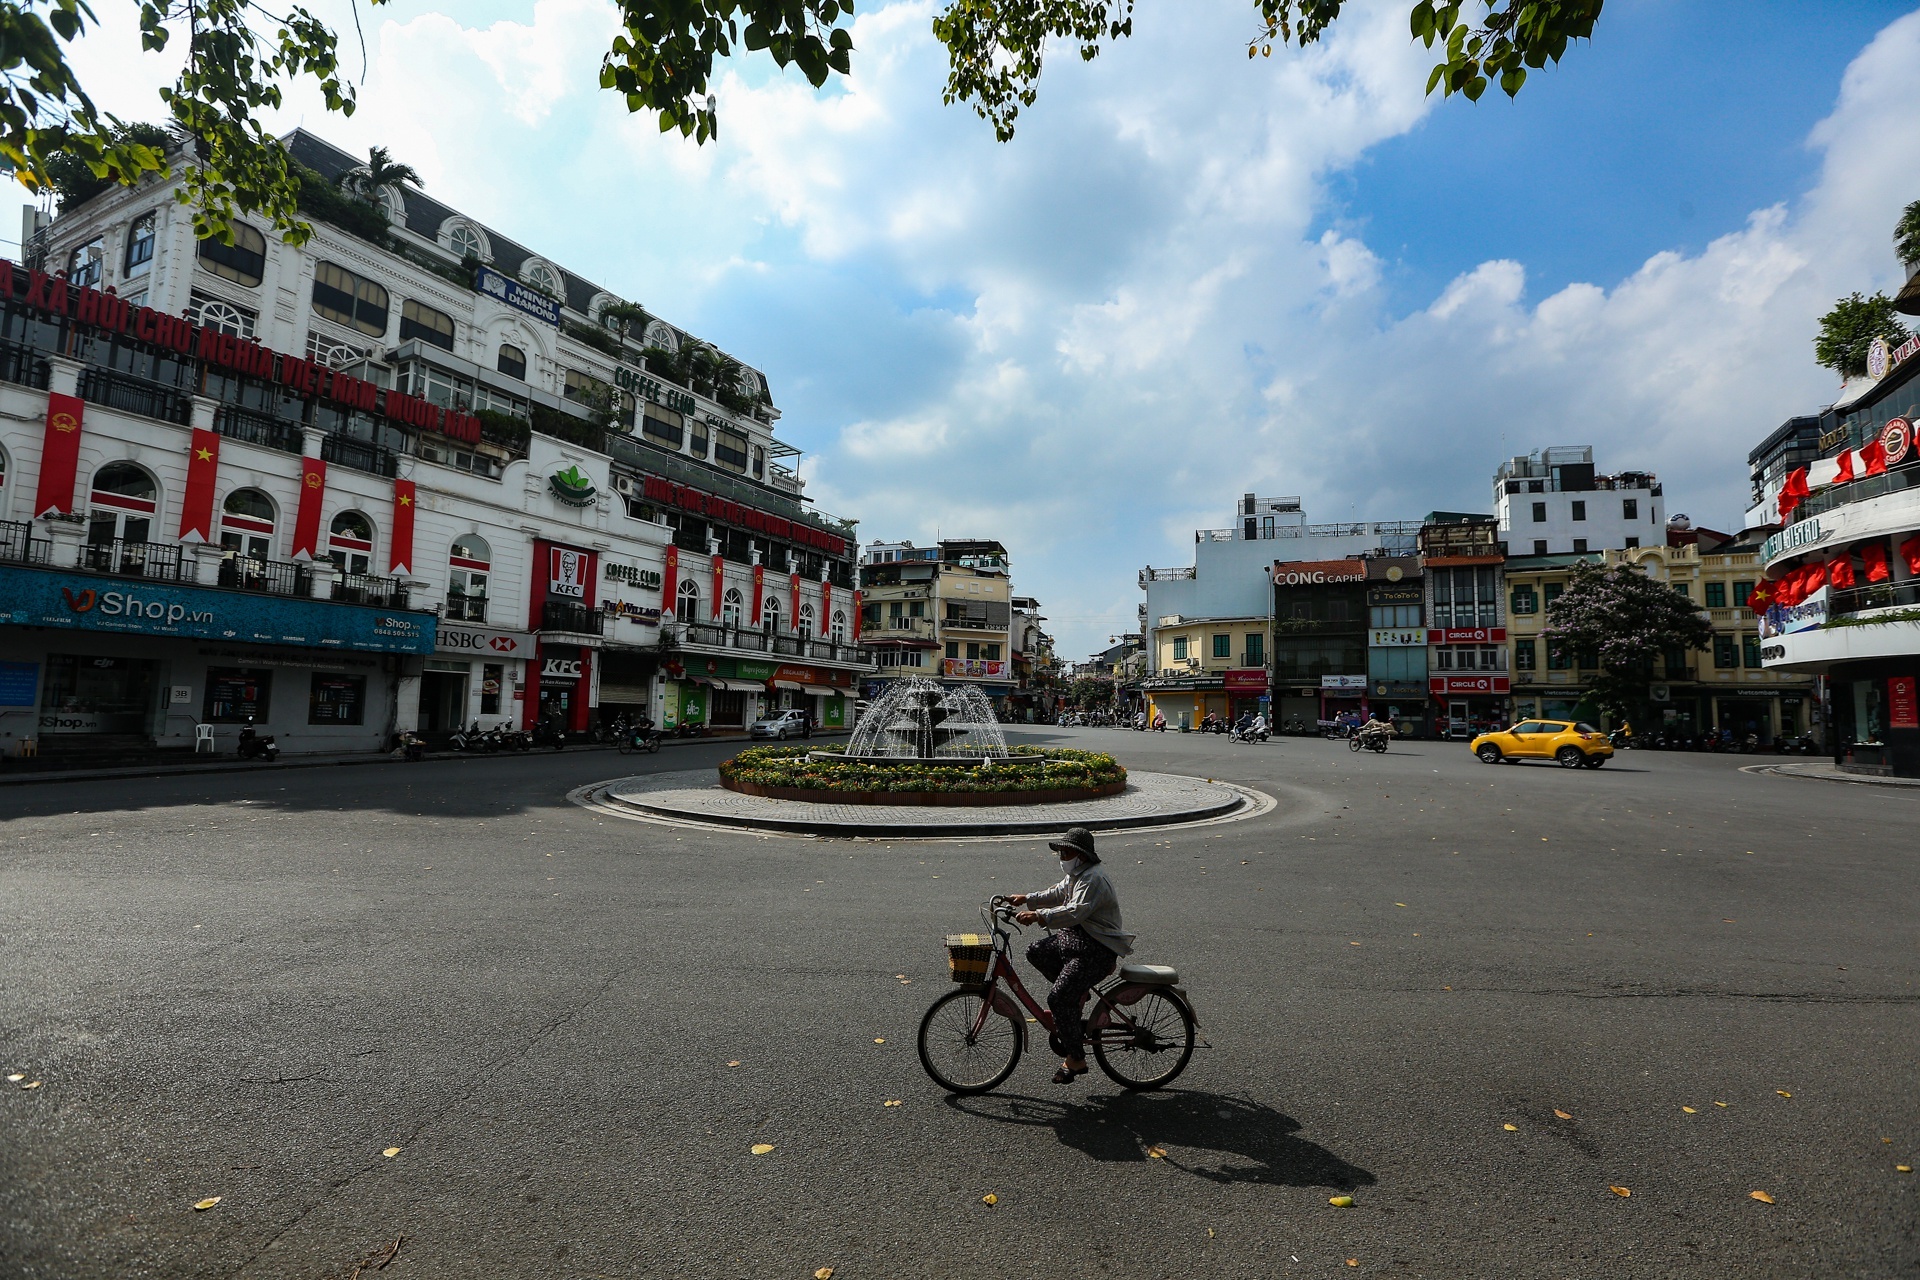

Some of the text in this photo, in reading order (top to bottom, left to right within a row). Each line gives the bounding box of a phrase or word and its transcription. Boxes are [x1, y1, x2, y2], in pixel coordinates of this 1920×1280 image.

[508, 292, 557, 322] DIAMOND
[515, 286, 553, 311] MINH
[25, 268, 68, 317] XÃ
[78, 285, 129, 337] HỘI
[137, 307, 193, 354] CHỦ
[198, 327, 273, 381] NGHĨA
[281, 353, 329, 399] VIỆT
[331, 371, 377, 412] NAM
[386, 390, 439, 432] MUÔN
[443, 403, 481, 445] NĂM
[614, 366, 695, 416] COFFEE CLUB
[1878, 421, 1907, 462] HIGHLANDS COFFEE
[547, 486, 596, 508] PHYTOPHARCO
[1783, 519, 1819, 549] BISTRO
[606, 563, 661, 585] COFFEE CLUB
[1275, 570, 1364, 587] CỘNG CAPHE
[555, 583, 580, 596] KFC
[436, 630, 486, 650] HSBC
[544, 658, 582, 674] KFC
